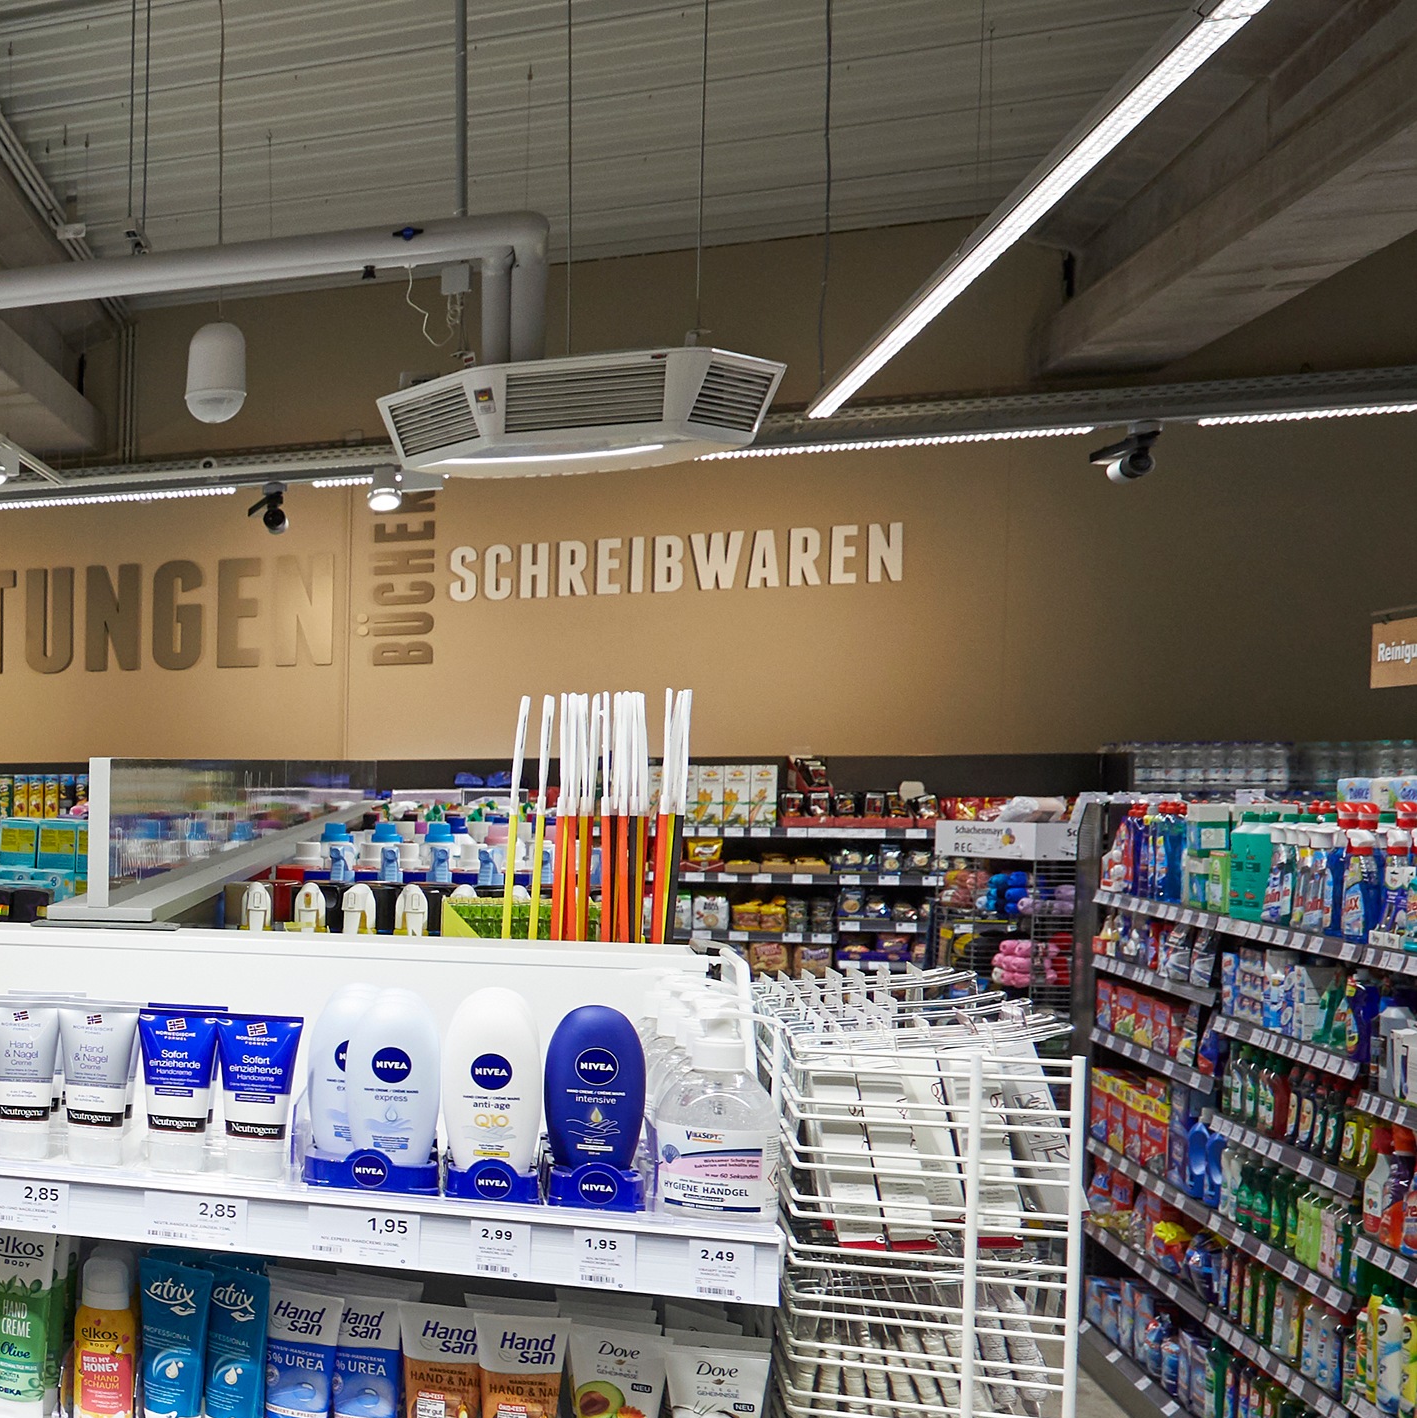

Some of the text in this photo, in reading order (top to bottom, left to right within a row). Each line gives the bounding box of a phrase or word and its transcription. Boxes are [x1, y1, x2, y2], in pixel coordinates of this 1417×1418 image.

[448, 521, 905, 602] SCHREIBWAREN
[9, 1039, 34, 1051] Hand
[4, 1050, 38, 1062] & Nagel
[161, 1049, 189, 1060] Sofort
[149, 1059, 201, 1071] einziehende
[376, 1060, 408, 1070] NIVEA
[475, 1066, 508, 1077] NIVEA
[580, 1061, 614, 1072] NIVEA
[374, 1093, 408, 1104] express
[473, 1100, 511, 1111] anti-age
[575, 1094, 617, 1105] intensive
[474, 1113, 510, 1128] Q10
[231, 1123, 279, 1136] Neutrogena
[665, 1181, 749, 1196] HYGIENE HANDGEL
[199, 1202, 237, 1218] 2,85
[366, 1217, 408, 1235] 1,95
[700, 1248, 734, 1262] 2,49
[145, 1277, 195, 1304] atrix
[2, 1299, 28, 1320] HAND
[273, 1300, 327, 1323] Hand
[1, 1318, 31, 1339] CREME
[500, 1331, 556, 1353] Hand
[0, 1341, 30, 1360] Olive
[516, 1347, 556, 1366] san
[83, 1361, 118, 1373] HONEY
[285, 1354, 325, 1372] UREA
[696, 1360, 739, 1379] Dove
[84, 1379, 120, 1390] SCHAUM
